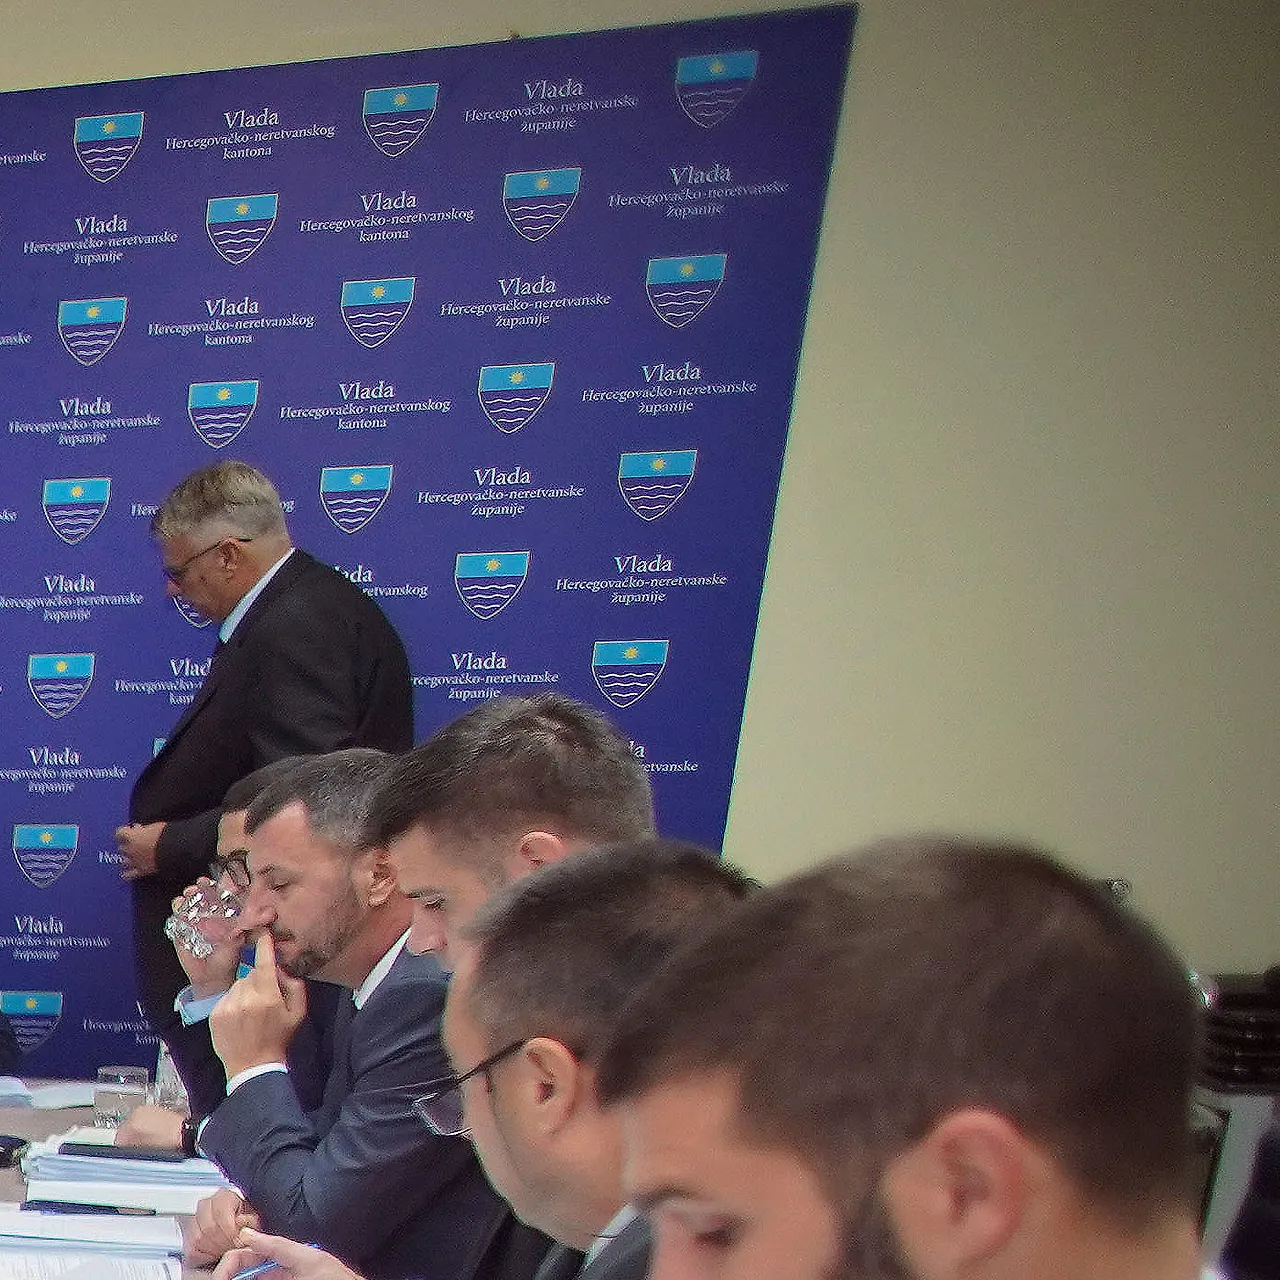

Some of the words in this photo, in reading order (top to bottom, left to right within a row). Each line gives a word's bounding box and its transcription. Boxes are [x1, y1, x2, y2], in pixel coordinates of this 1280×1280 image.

[524, 78, 585, 100] Vlada
[224, 108, 279, 128] Vlada
[521, 117, 576, 134] županije
[223, 145, 271, 160] kantona
[669, 161, 733, 185] Vlada
[358, 190, 419, 211] Vlada
[75, 215, 128, 234] Vlada
[360, 230, 411, 245] kantona
[74, 250, 123, 266] županije
[498, 276, 556, 295] Vlada
[204, 297, 259, 316] Vlada
[496, 313, 550, 329] županije
[205, 333, 252, 345] kantona
[642, 362, 702, 382] Vlada
[339, 380, 396, 400] Vlada
[60, 397, 111, 416] Vlada
[638, 400, 693, 415] županije
[338, 416, 386, 429] kantona
[474, 467, 531, 486] Vlada
[470, 502, 524, 520] županije
[613, 554, 674, 573] Vlada
[44, 574, 95, 592] Vlada
[610, 589, 667, 606] županije
[169, 657, 213, 677] Vlad
[452, 651, 509, 669] Vlada
[412, 670, 559, 689] rcegovačko-neretvanske
[448, 687, 501, 702] županije
[30, 746, 81, 765] Vlada
[14, 915, 63, 933] Vlada
